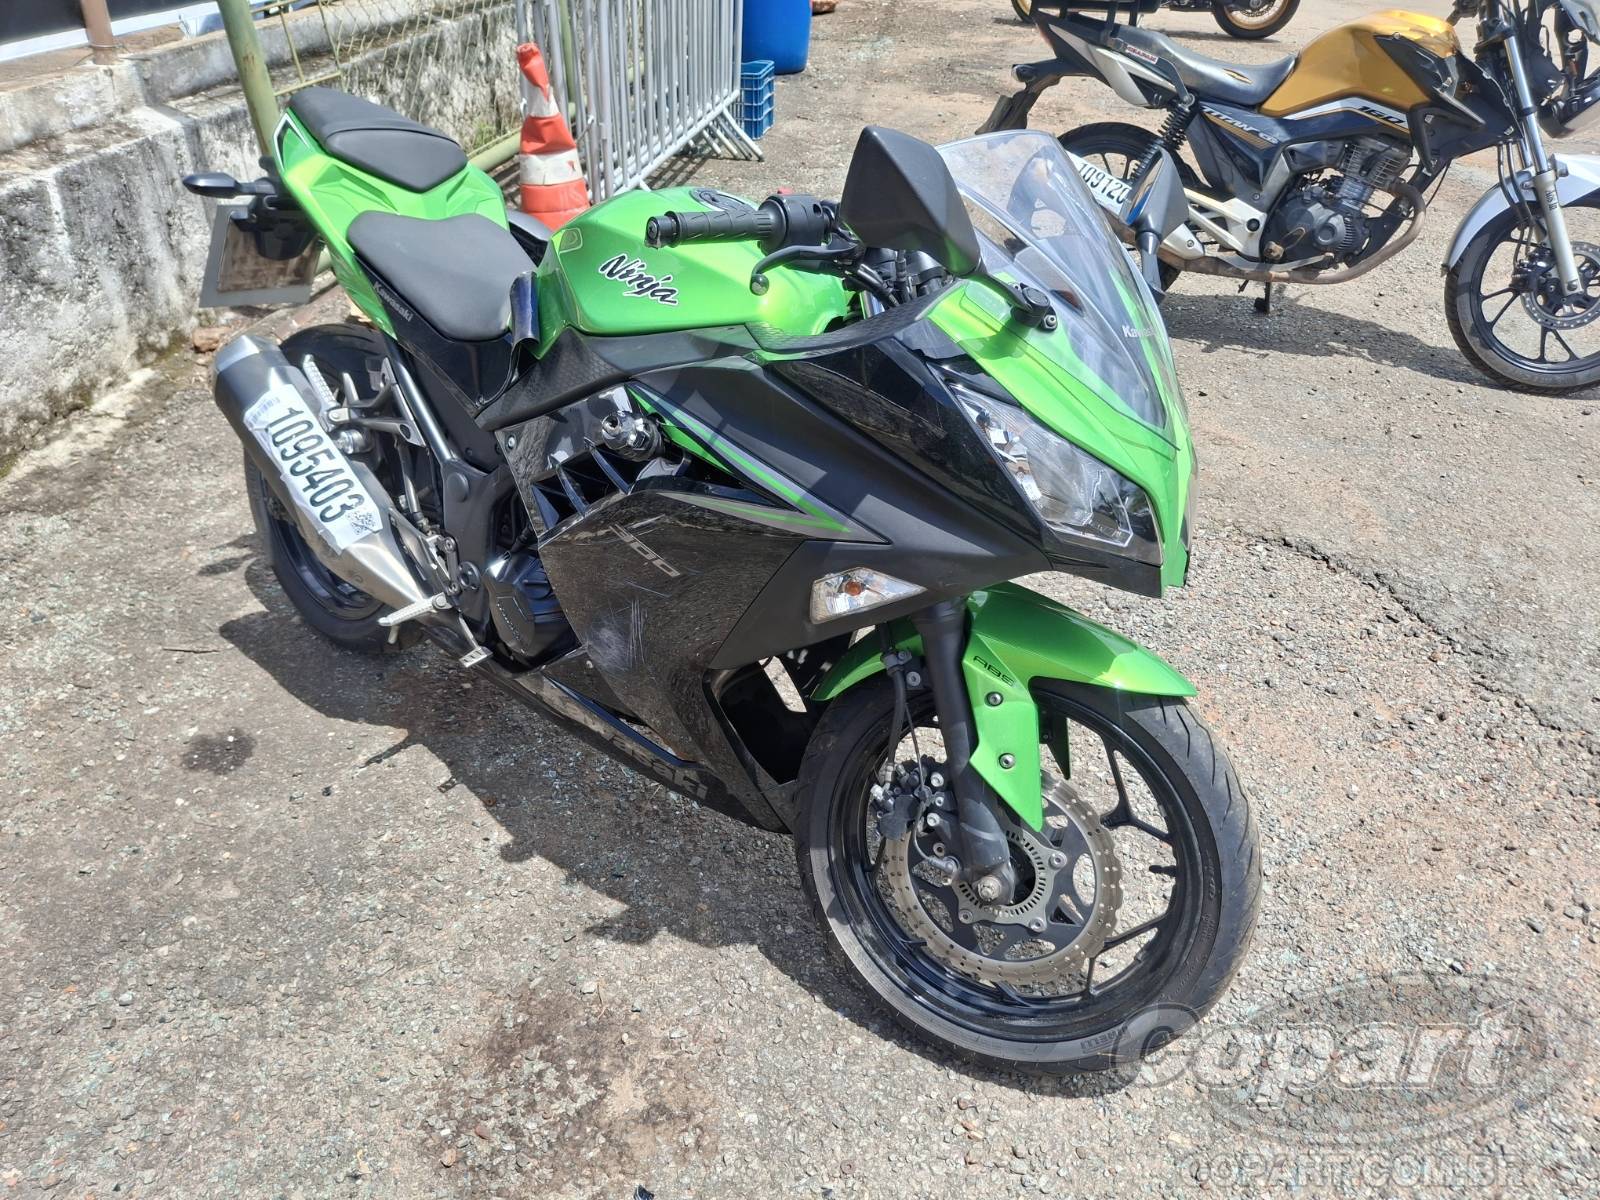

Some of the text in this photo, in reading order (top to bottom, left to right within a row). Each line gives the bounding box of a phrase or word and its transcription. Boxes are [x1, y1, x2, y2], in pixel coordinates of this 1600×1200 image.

[1358, 105, 1405, 123] 160
[599, 253, 678, 306] Ninja
[372, 281, 414, 322] Kawasaki
[267, 407, 366, 523] 1095403
[973, 655, 1015, 687] ABS
